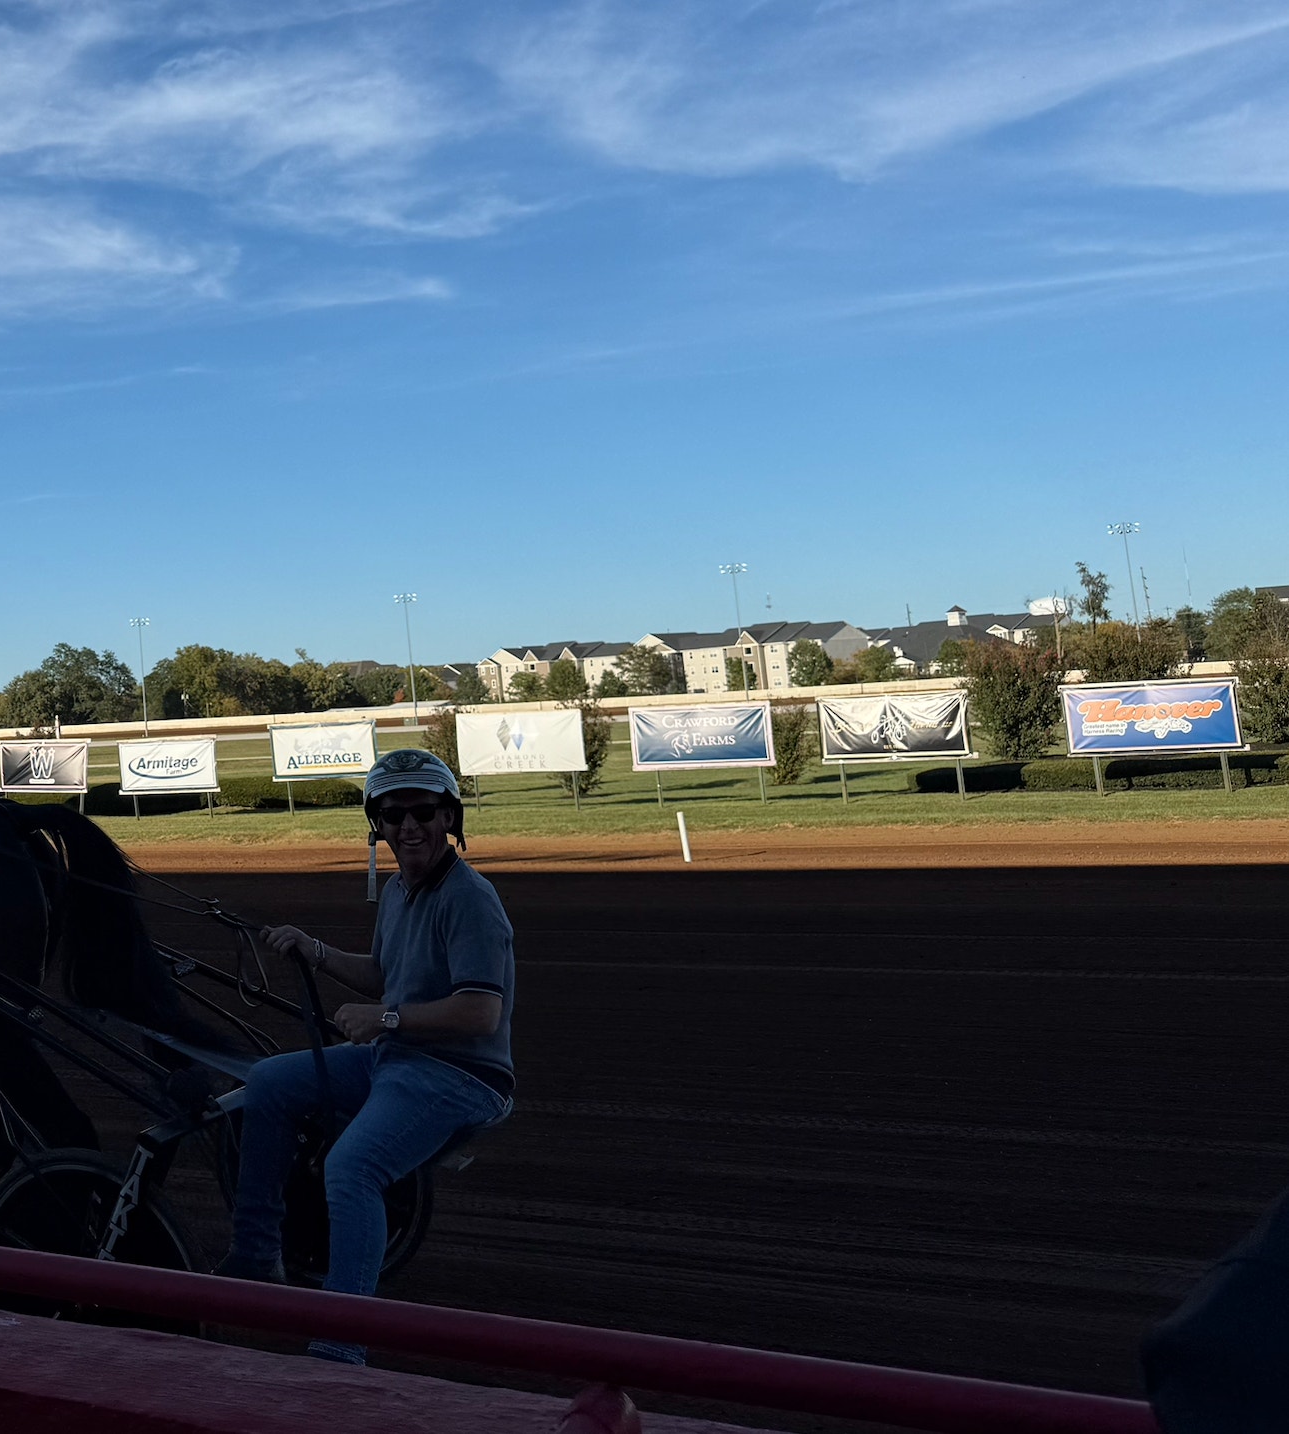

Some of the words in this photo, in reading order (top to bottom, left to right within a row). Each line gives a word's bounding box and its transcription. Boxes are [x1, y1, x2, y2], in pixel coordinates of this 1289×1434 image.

[1079, 700, 1222, 722] Hanover
[662, 714, 738, 728] CRAWFORD
[692, 733, 736, 747] FARMS
[136, 755, 199, 771] Armitage
[287, 752, 362, 770] ALLERAGE
[494, 760, 548, 769] CREEK
